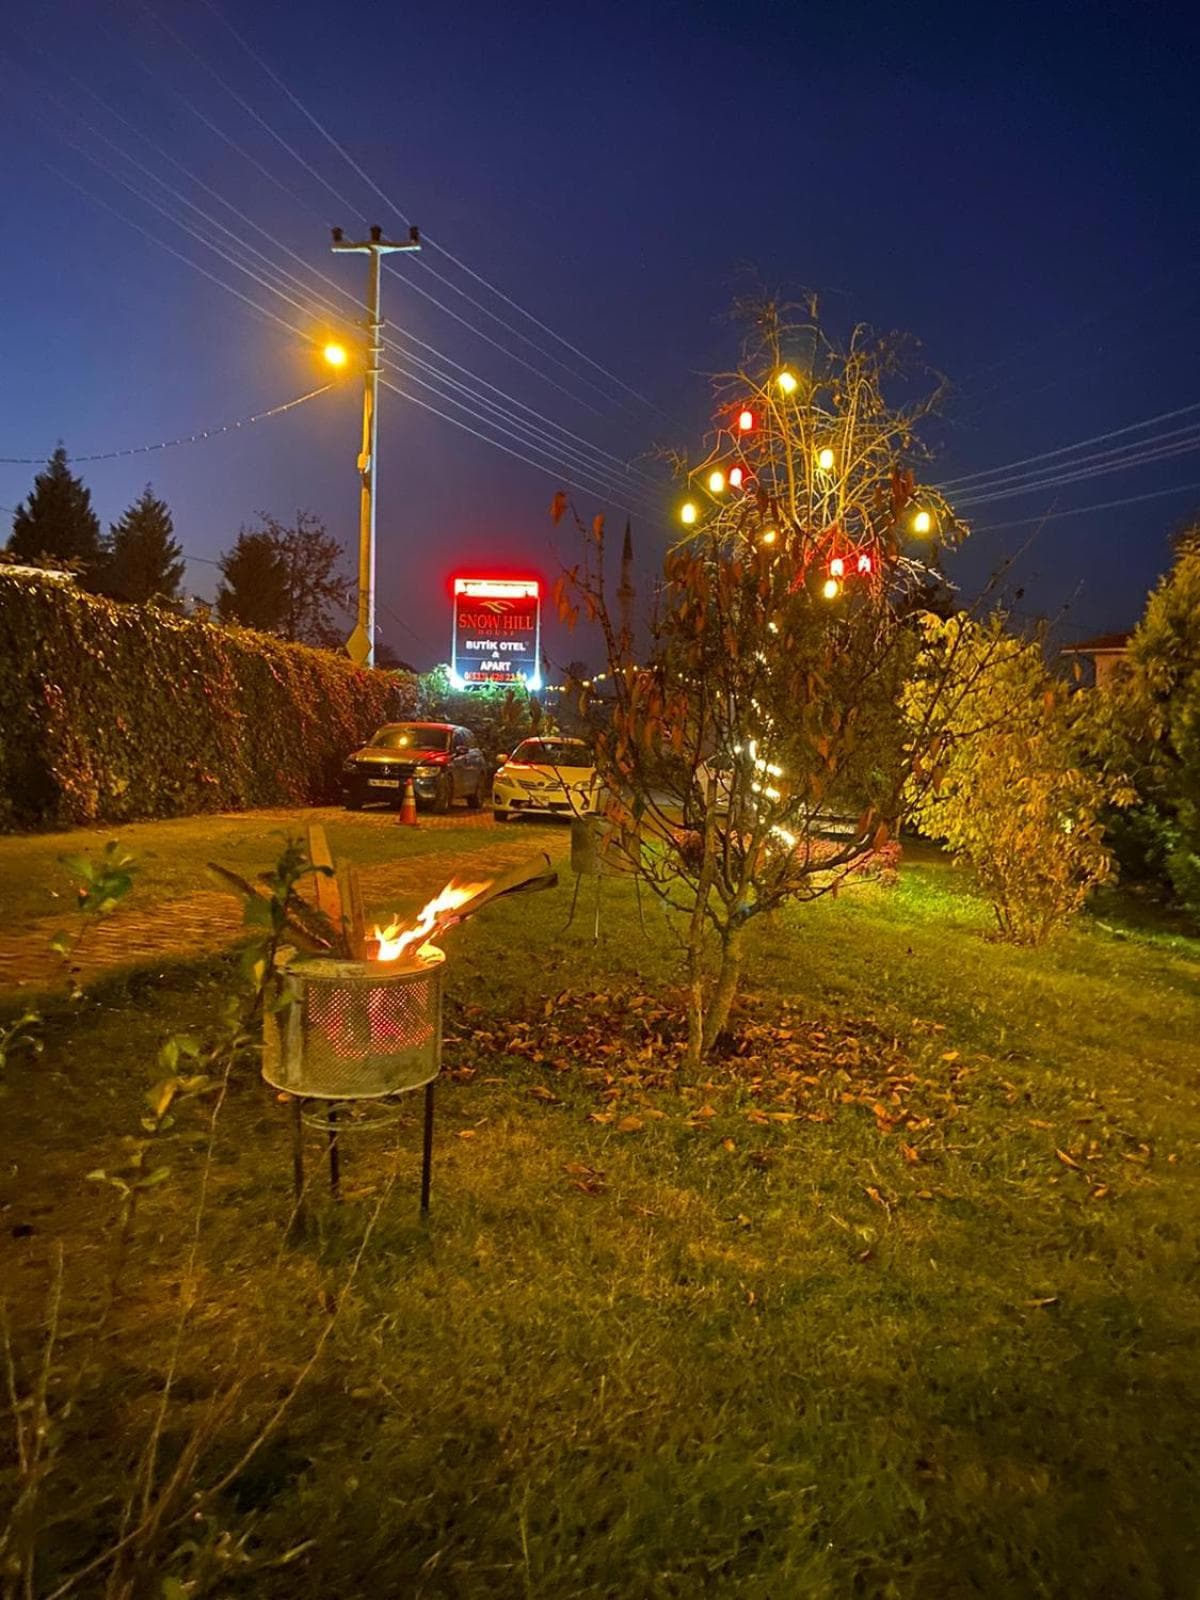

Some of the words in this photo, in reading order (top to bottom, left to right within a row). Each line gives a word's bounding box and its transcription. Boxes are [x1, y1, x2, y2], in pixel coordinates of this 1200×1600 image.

[459, 613, 500, 629] SNOW
[503, 615, 534, 631] HILL
[465, 640, 498, 650] BUTİK
[499, 642, 526, 651] OTEL
[480, 661, 511, 671] APART
